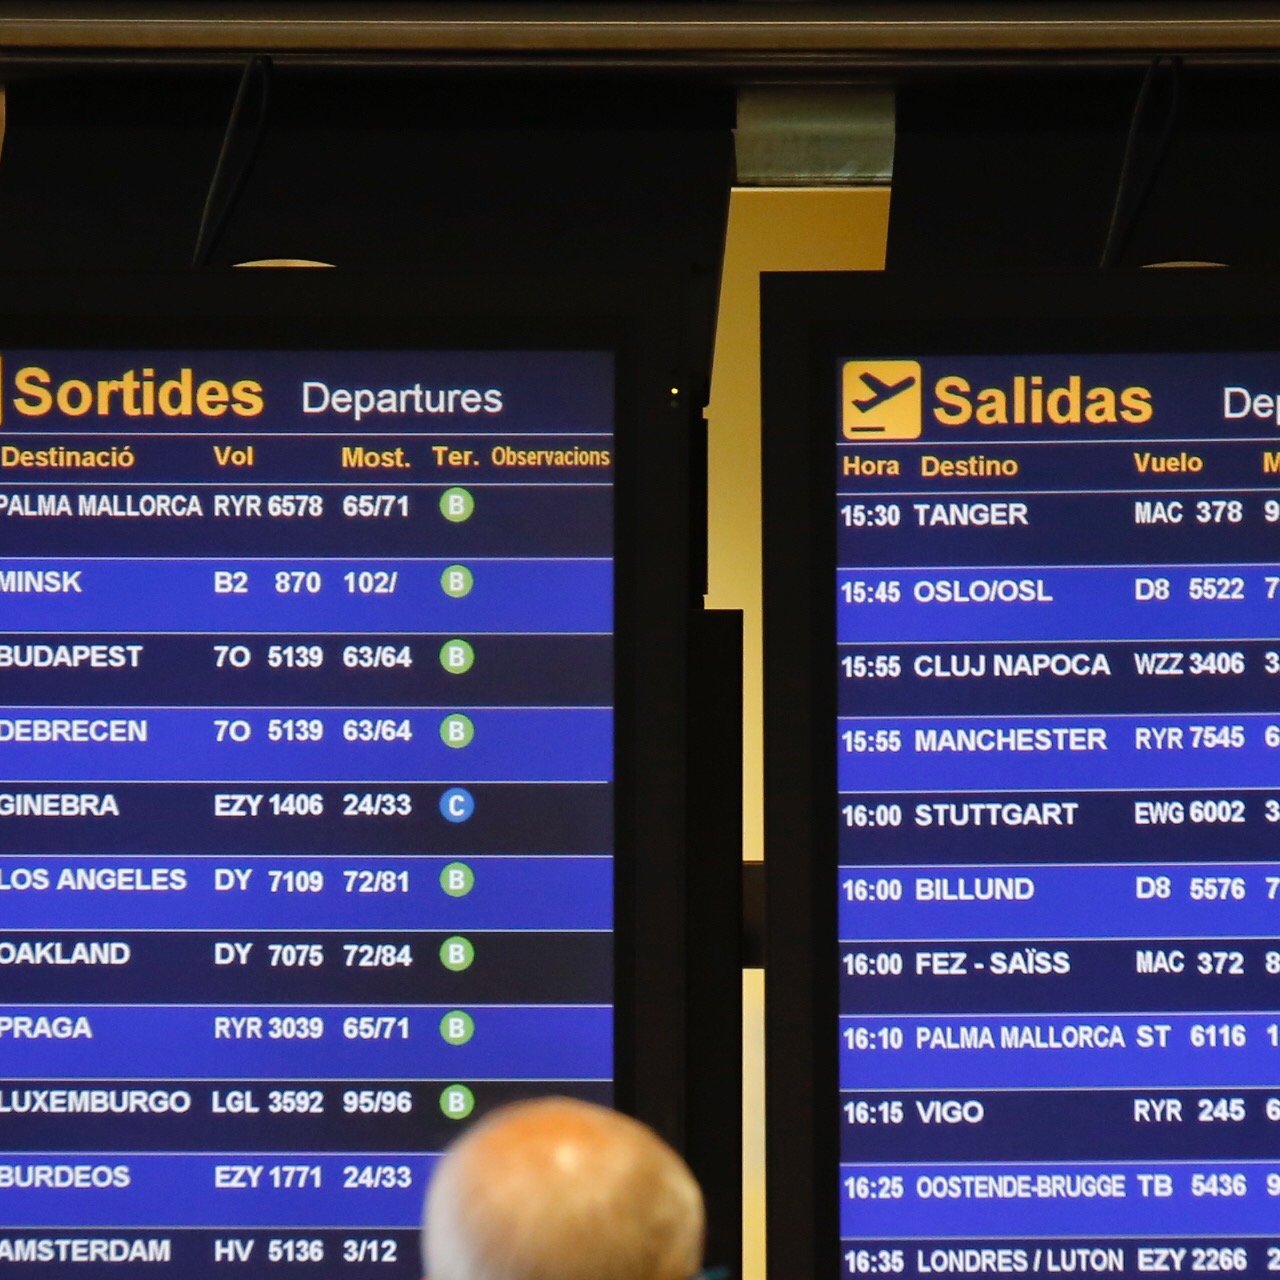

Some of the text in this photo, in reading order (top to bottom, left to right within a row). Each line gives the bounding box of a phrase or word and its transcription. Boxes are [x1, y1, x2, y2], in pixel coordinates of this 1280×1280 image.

[13, 366, 264, 417] Sortides
[302, 381, 503, 422] Departures
[933, 375, 1153, 426] Salidas
[0, 445, 136, 469] Destinació
[213, 445, 254, 467] Vol
[341, 446, 411, 469] Most.
[431, 445, 480, 468] Ter.
[490, 445, 611, 467] Observacions
[843, 455, 900, 476] Hora
[921, 455, 1019, 478] Destino
[1133, 452, 1204, 473] Vuelo
[214, 571, 248, 594] B2
[275, 571, 322, 594] 870
[343, 571, 398, 594] 102/
[449, 571, 465, 591] B
[841, 580, 901, 604] 15:45
[913, 579, 1054, 603] OSLO/OSL
[1135, 578, 1170, 601] D8
[1189, 577, 1245, 600] 5522
[841, 729, 902, 753] 15:55
[915, 727, 1108, 752] MANCHESTER
[1135, 727, 1183, 750] RYR
[1189, 725, 1245, 749] 7545
[56, 868, 187, 891] ANGELES
[214, 868, 253, 891] DY
[268, 870, 324, 893] 7109
[343, 870, 409, 893] 72/81
[448, 869, 465, 890] B
[214, 1165, 264, 1188] EZY
[269, 1165, 321, 1188] 1771
[343, 1165, 412, 1188] 24/33
